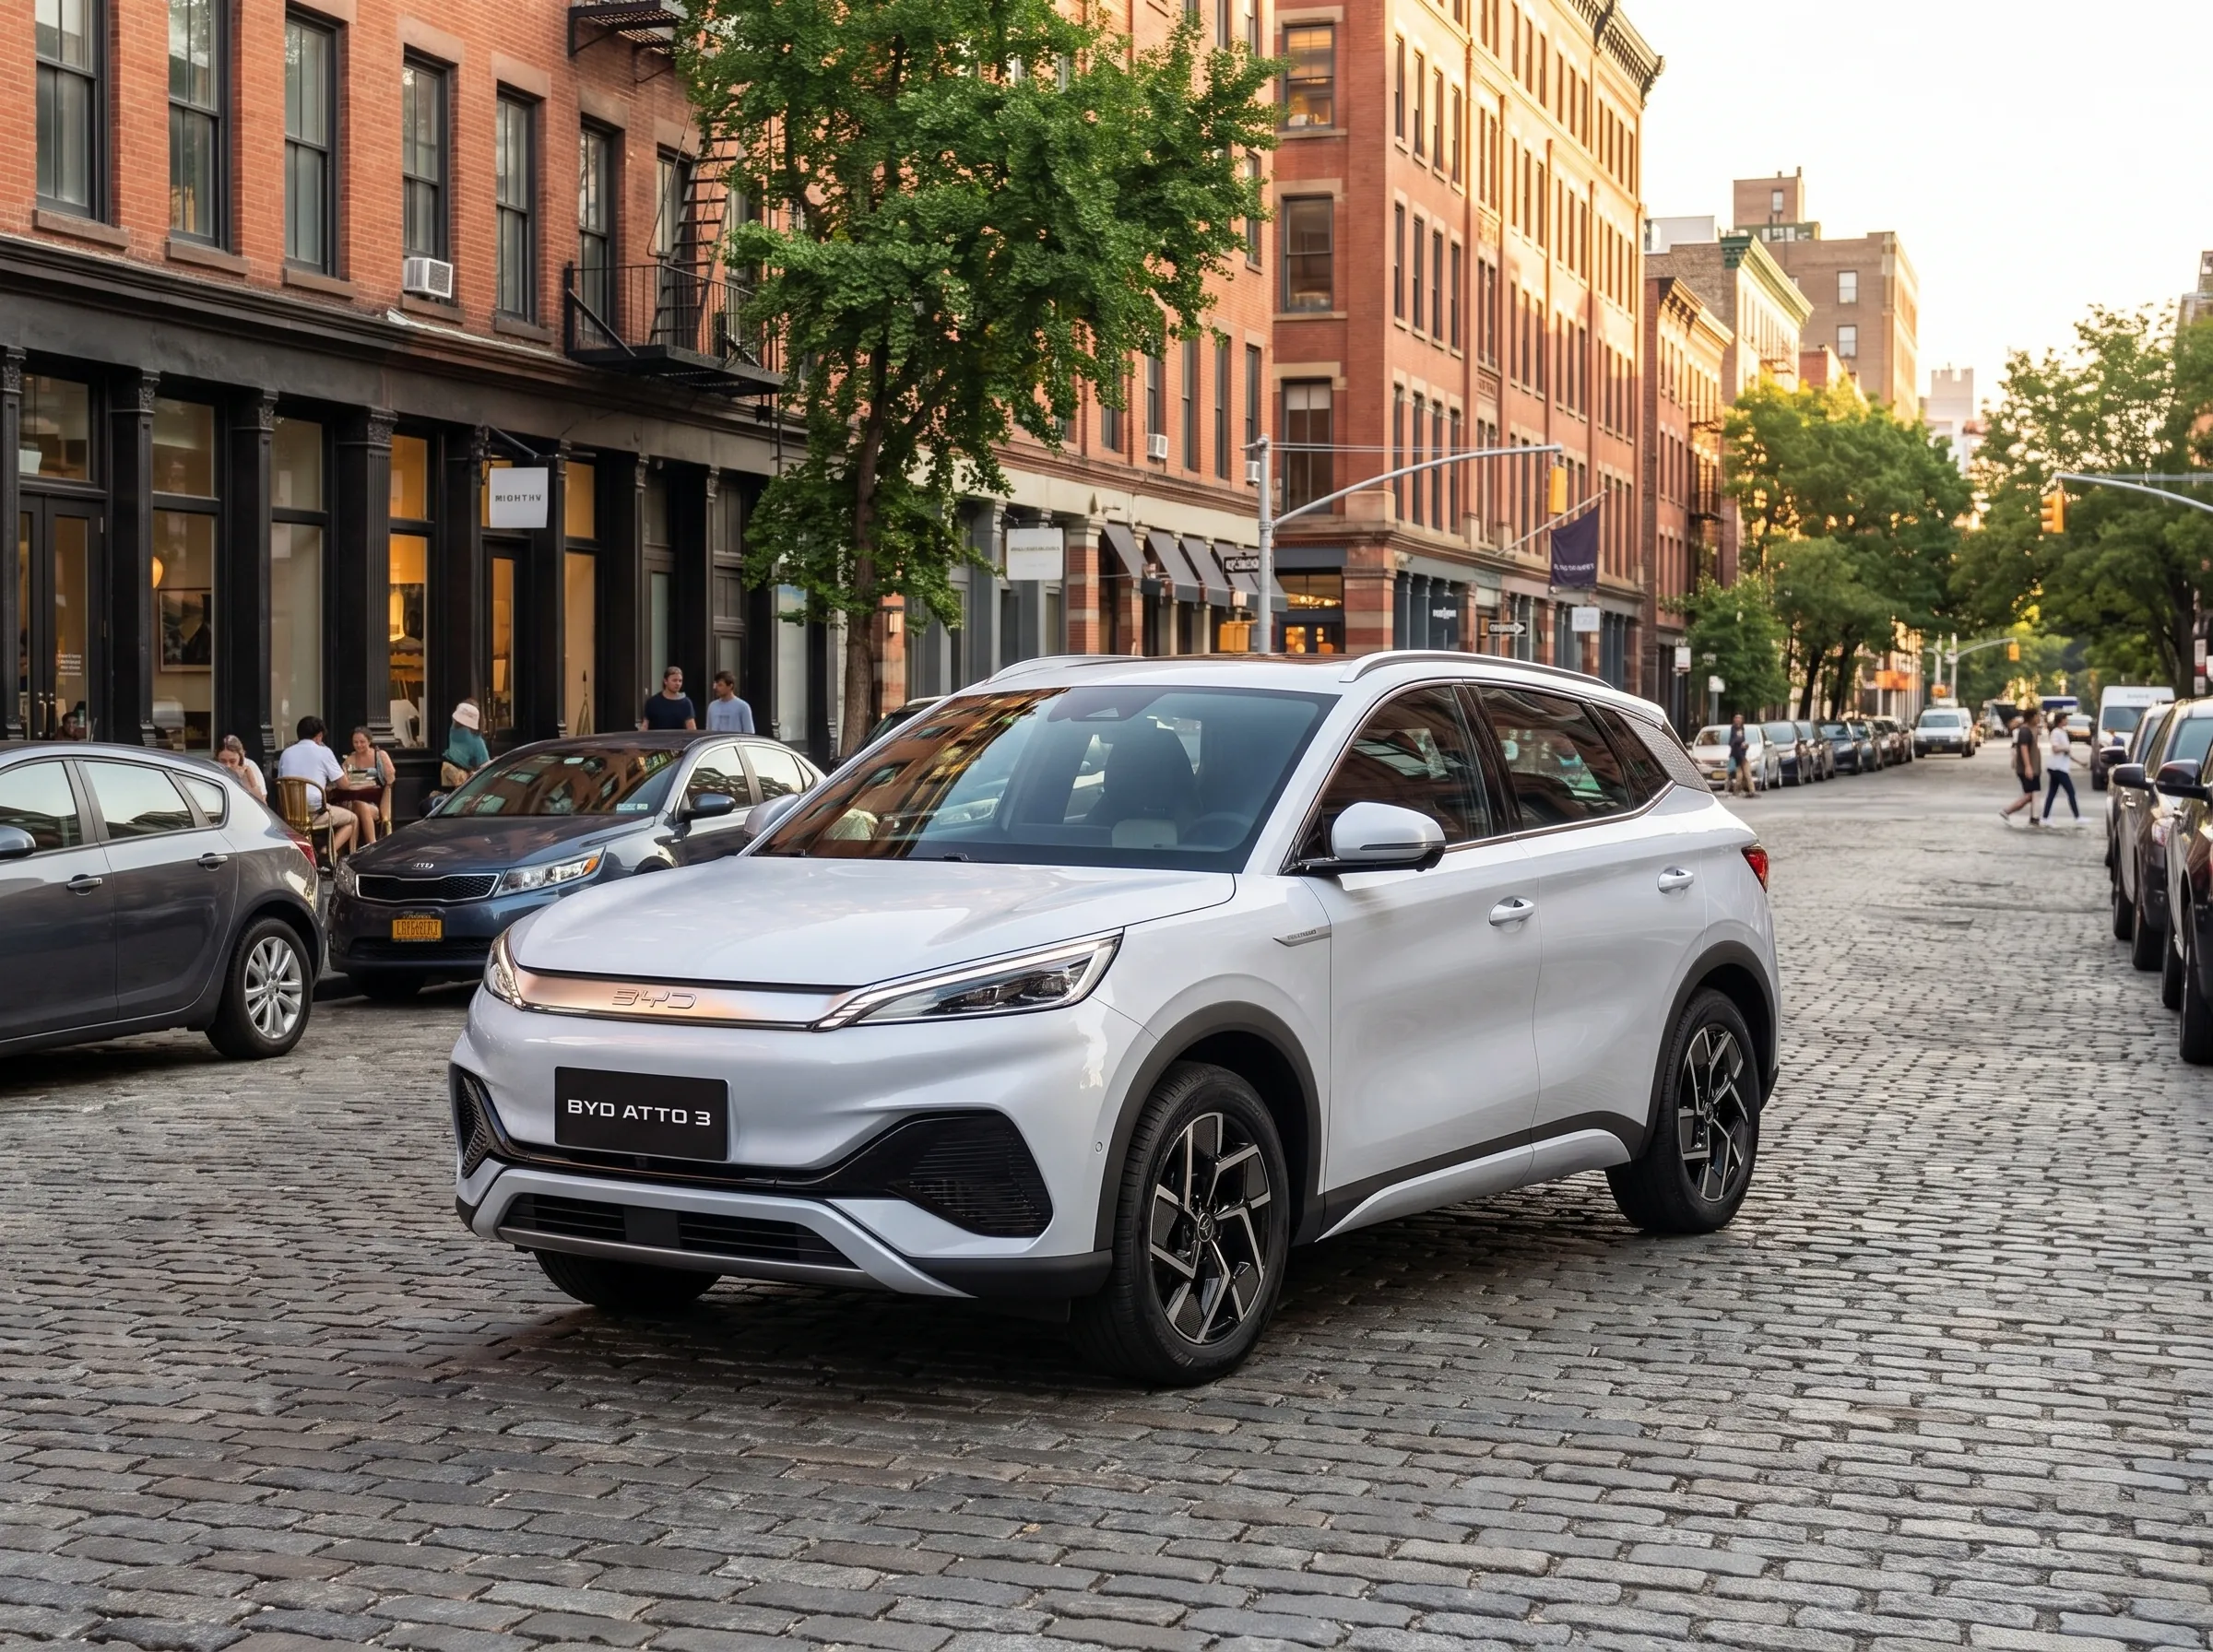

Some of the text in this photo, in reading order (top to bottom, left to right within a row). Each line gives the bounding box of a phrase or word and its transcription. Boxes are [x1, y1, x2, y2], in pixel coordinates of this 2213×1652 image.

[611, 988, 697, 1009] BYD
[567, 1099, 711, 1127] BYD ATTO 3
